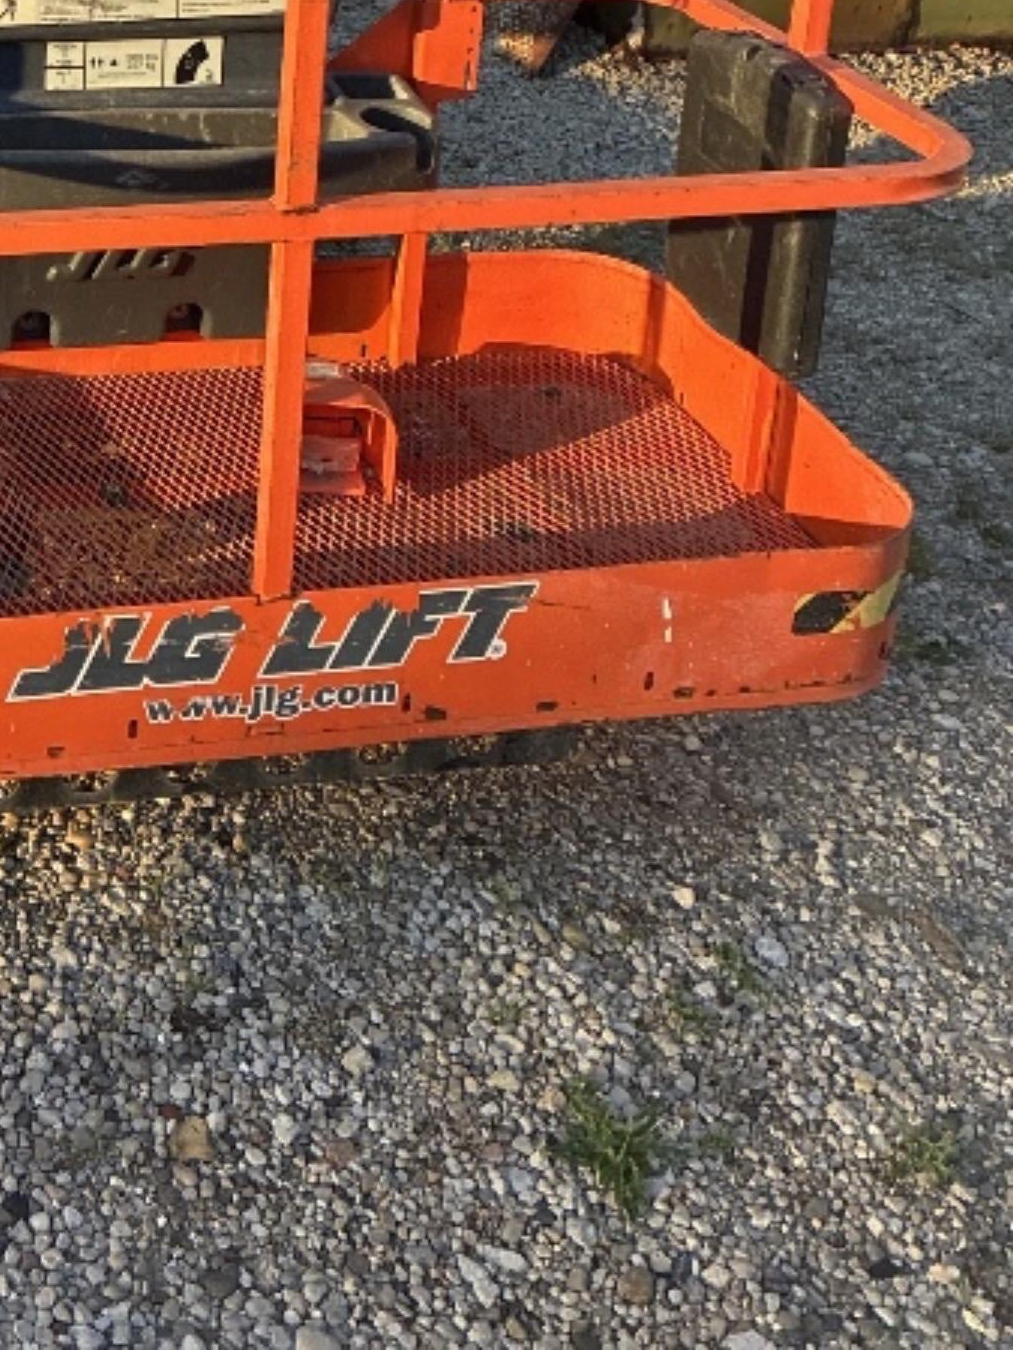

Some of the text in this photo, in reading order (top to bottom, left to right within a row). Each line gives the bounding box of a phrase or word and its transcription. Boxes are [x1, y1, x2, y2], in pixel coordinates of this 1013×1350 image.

[5, 580, 539, 703] JLG LIFT
[143, 680, 399, 724] www.jlg.com
